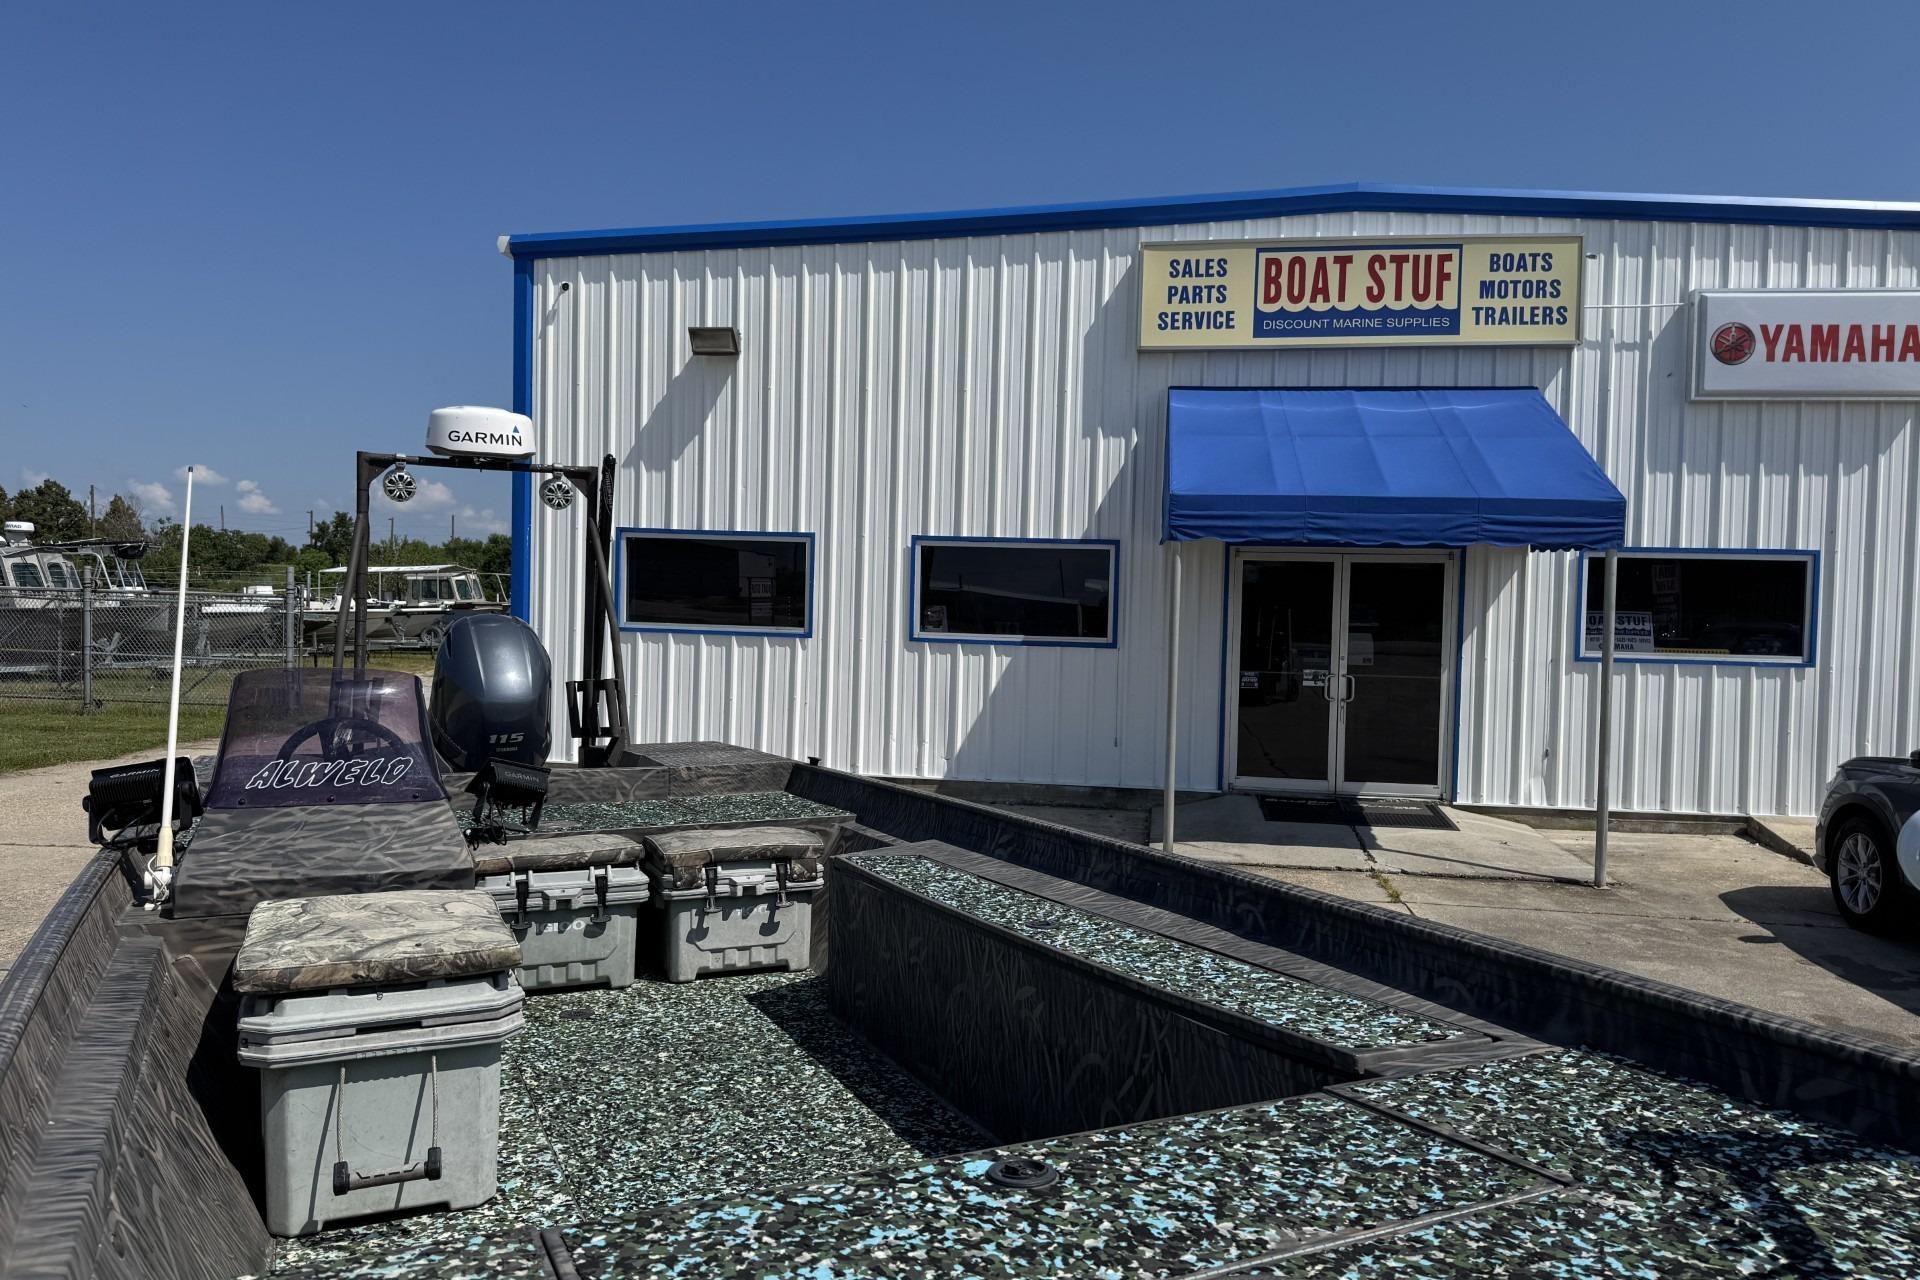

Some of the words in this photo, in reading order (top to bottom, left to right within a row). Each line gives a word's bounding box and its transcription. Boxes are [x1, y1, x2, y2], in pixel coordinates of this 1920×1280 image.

[1168, 258, 1228, 279] SALES
[1489, 252, 1553, 273] BOATS
[1263, 255, 1353, 304] BOAT
[1366, 253, 1453, 303] STUF
[1479, 279, 1561, 299] MOTORS
[1167, 284, 1227, 305] PARTS
[1157, 310, 1235, 330] SERVICE
[1263, 318, 1329, 330] DISCOUNT
[1333, 317, 1383, 329] MARINE
[1386, 317, 1450, 328] SUPPLIES
[1471, 305, 1568, 326] TRAILERS
[1760, 324, 1920, 362] YAMAHA
[448, 429, 522, 447] GARMIN
[489, 732, 525, 744] 115
[245, 757, 415, 789] ALWELD
[504, 771, 539, 783] GARMIN
